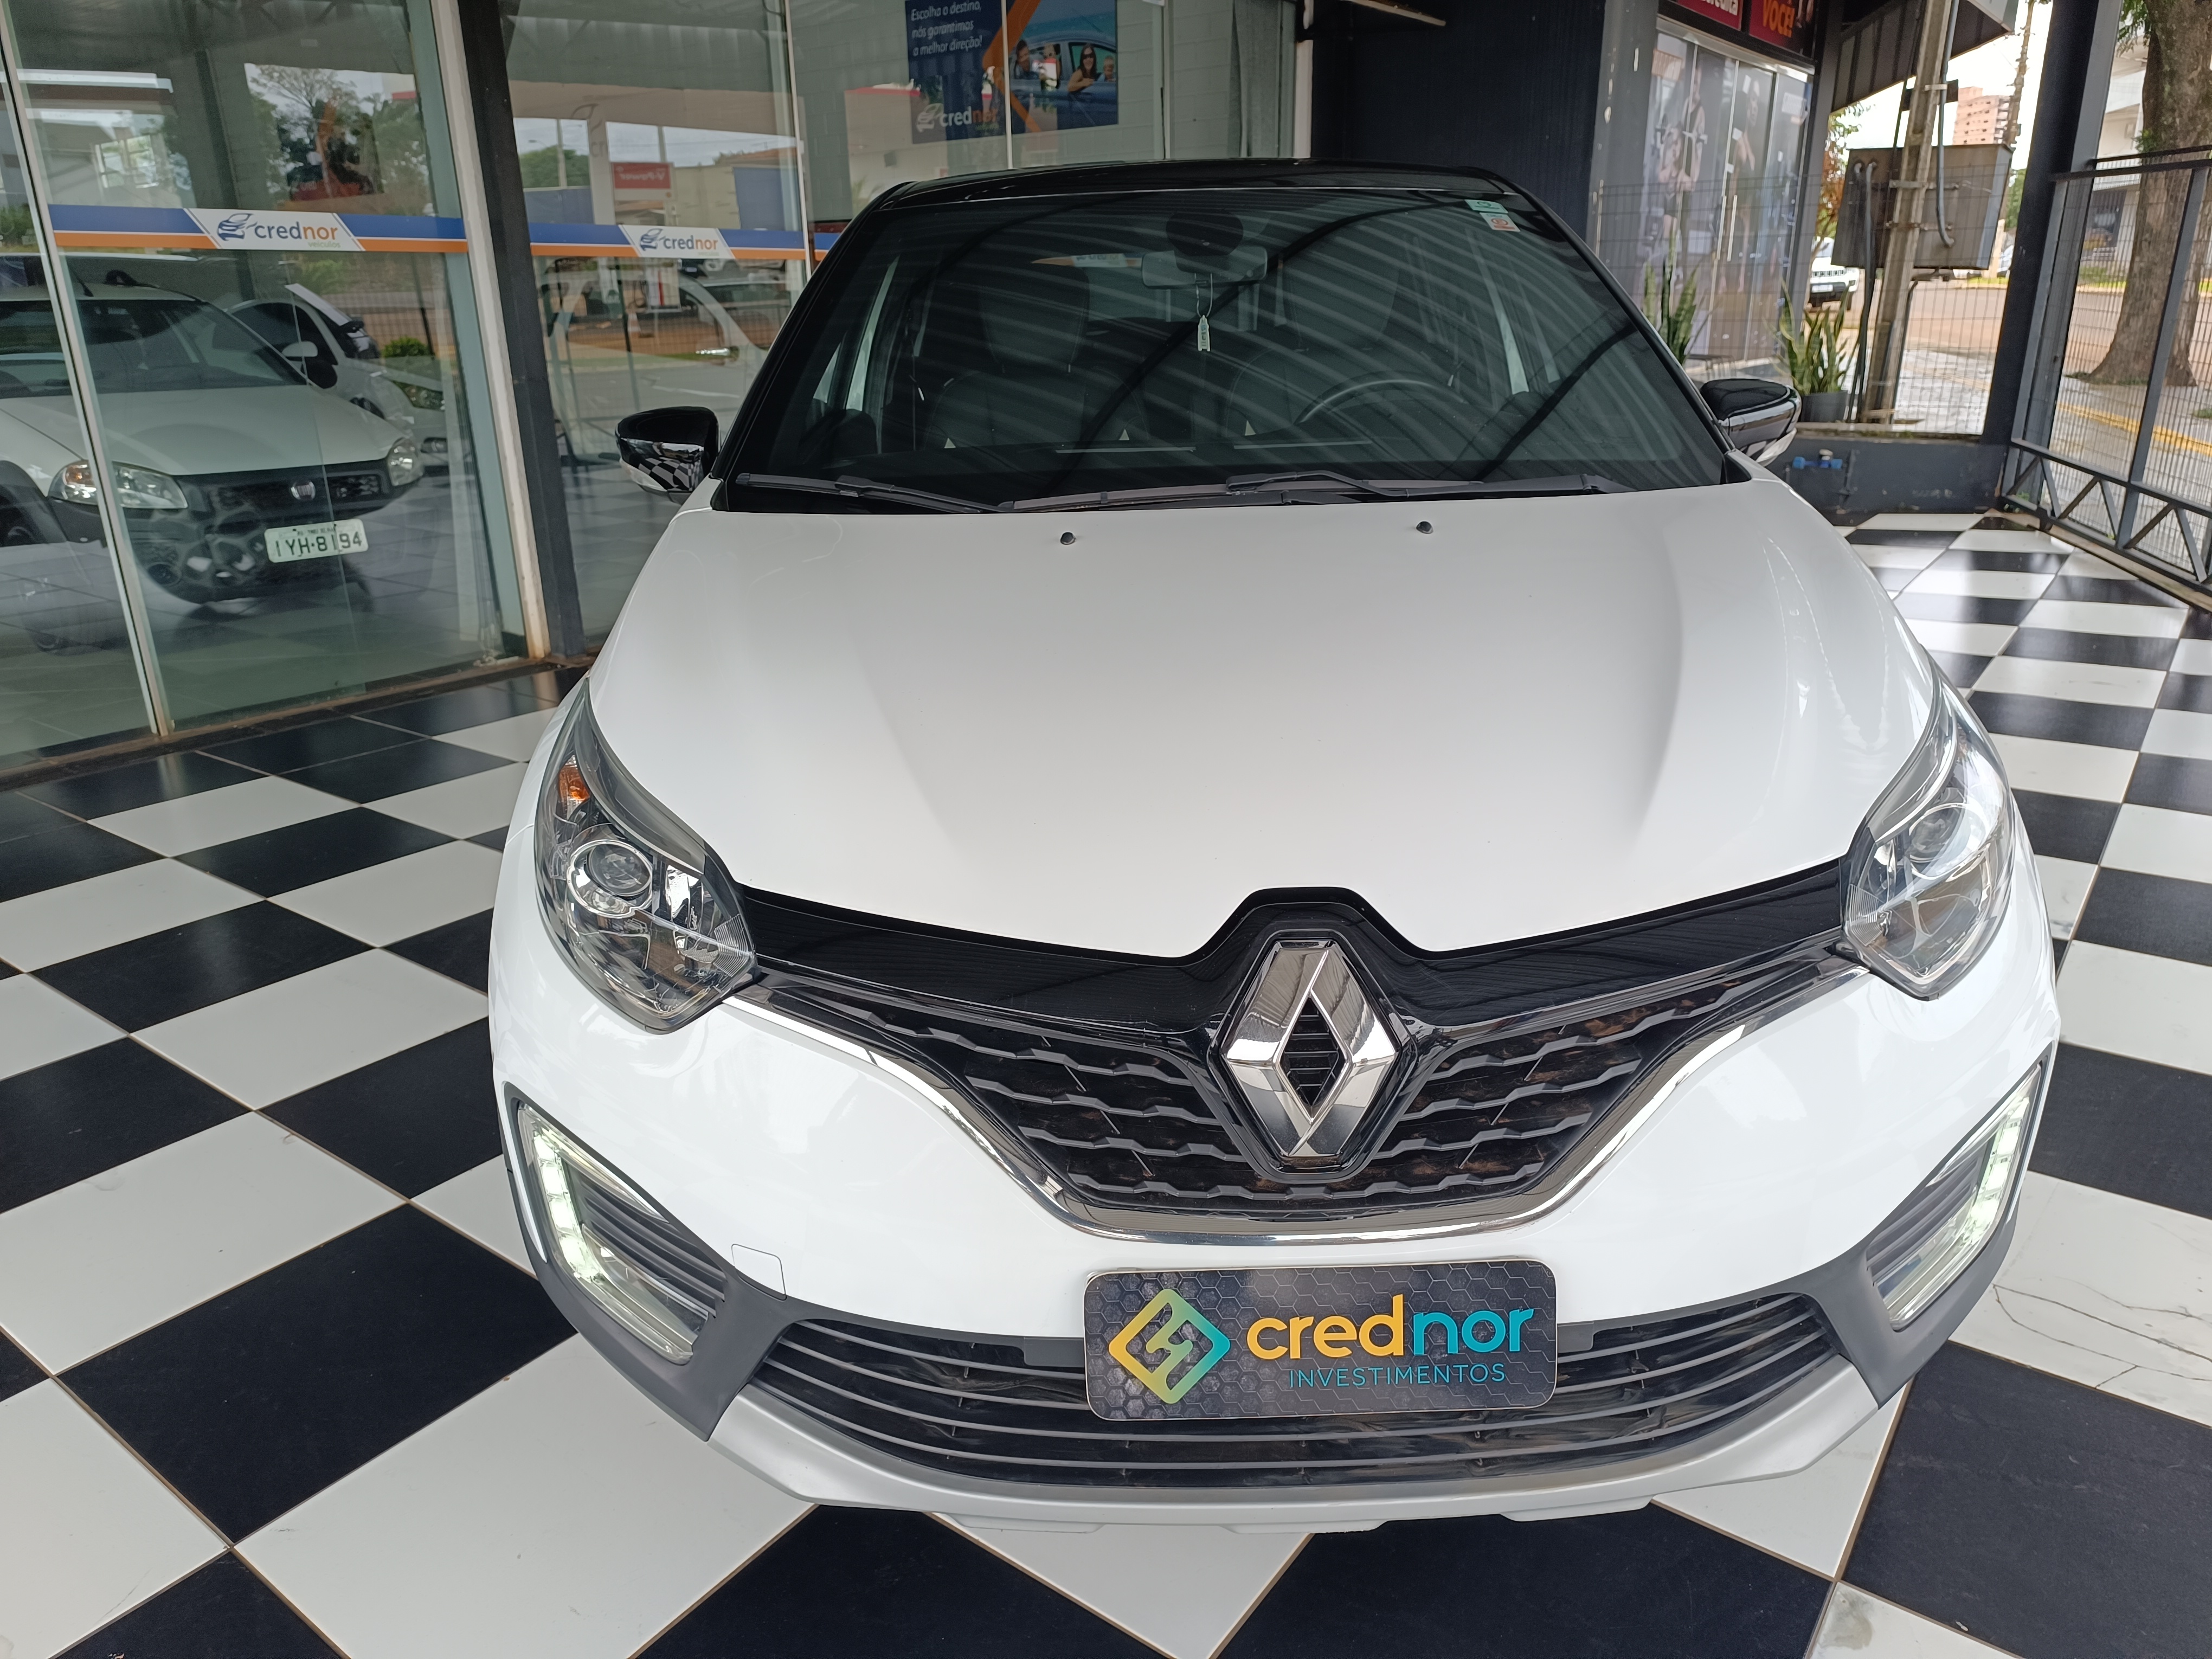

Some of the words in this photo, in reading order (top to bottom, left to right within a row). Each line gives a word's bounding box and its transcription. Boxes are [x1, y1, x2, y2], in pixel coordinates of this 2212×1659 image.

[911, 5, 941, 21] Escolha
[942, 6, 949, 16] o
[949, 1, 982, 15] destino,
[911, 26, 927, 38] nós
[927, 21, 974, 40] garantimos
[912, 47, 919, 56] a
[920, 41, 948, 55] melhor
[949, 35, 982, 52] direção!
[940, 106, 998, 127] crednor
[254, 221, 338, 240] crednor
[663, 235, 718, 250] crednor
[1246, 1294, 1534, 1360] crednor
[1290, 1363, 1506, 1388] INVESTIMENTOS
